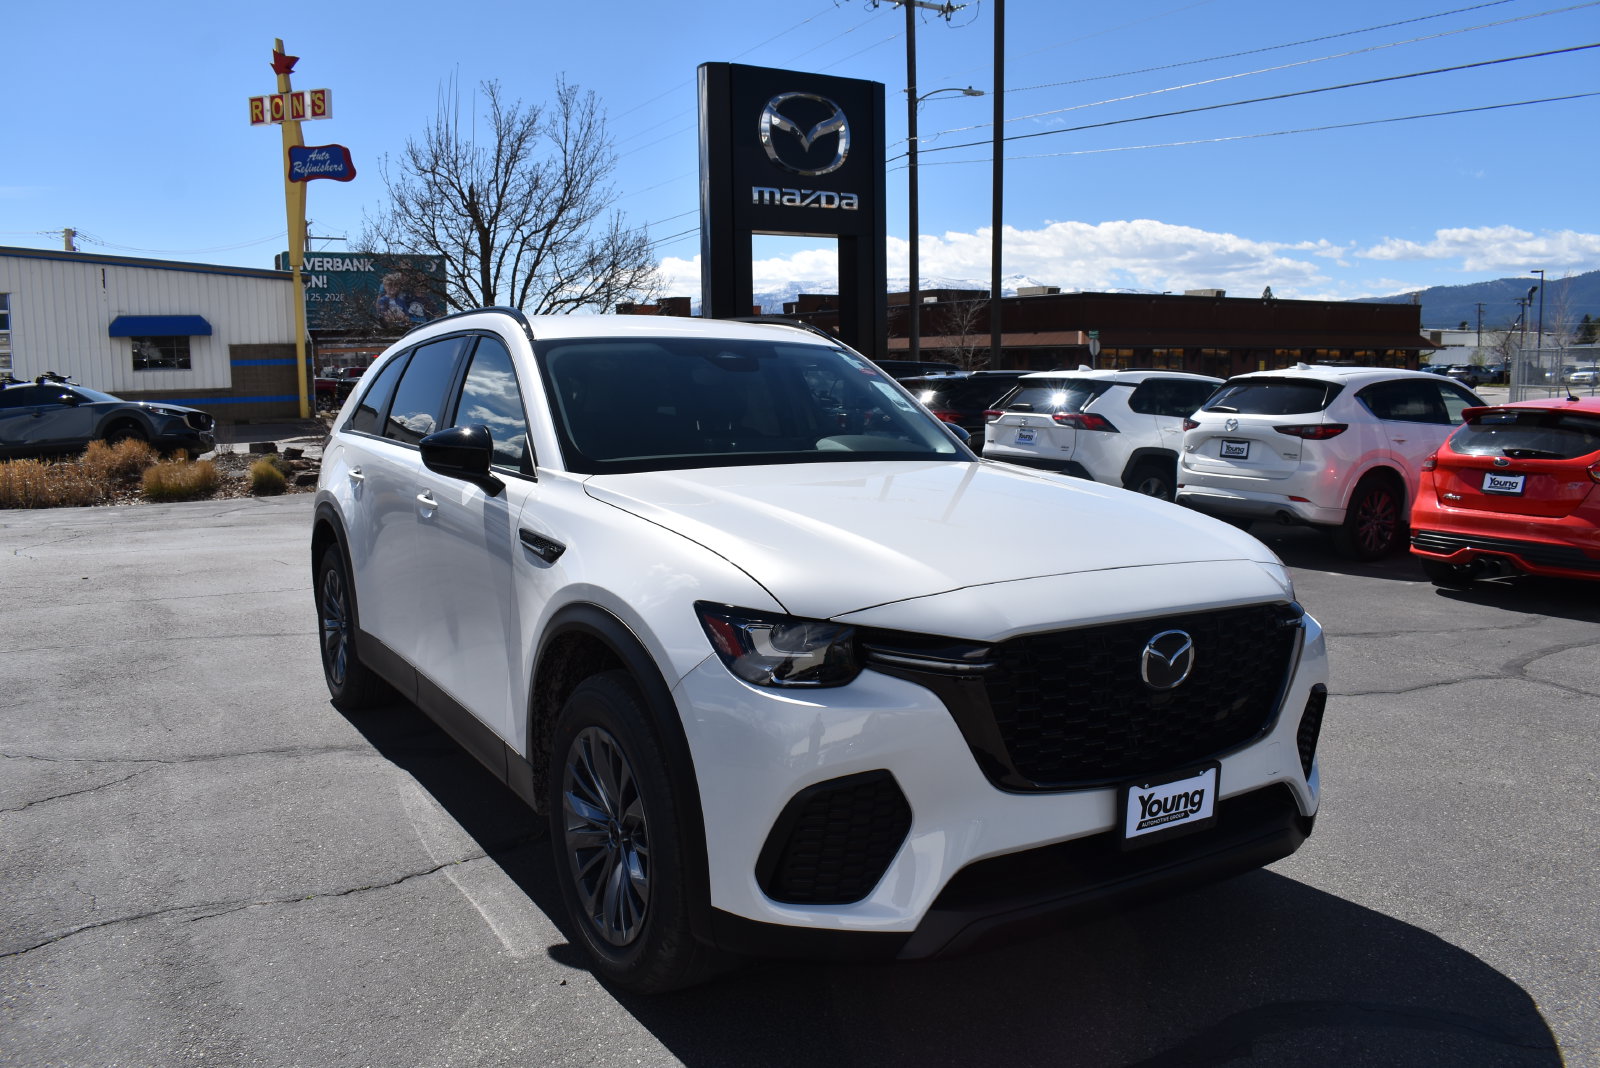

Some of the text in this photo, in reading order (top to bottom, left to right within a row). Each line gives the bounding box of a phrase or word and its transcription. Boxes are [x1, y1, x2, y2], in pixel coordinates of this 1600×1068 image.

[307, 148, 330, 161] Auto
[293, 160, 344, 177] Refinishers
[752, 186, 858, 210] mazda
[1226, 443, 1245, 455] Young
[1489, 476, 1519, 490] Young
[1138, 788, 1205, 820] Young
[1141, 811, 1185, 828] AUTOMOTIVE GROUP
